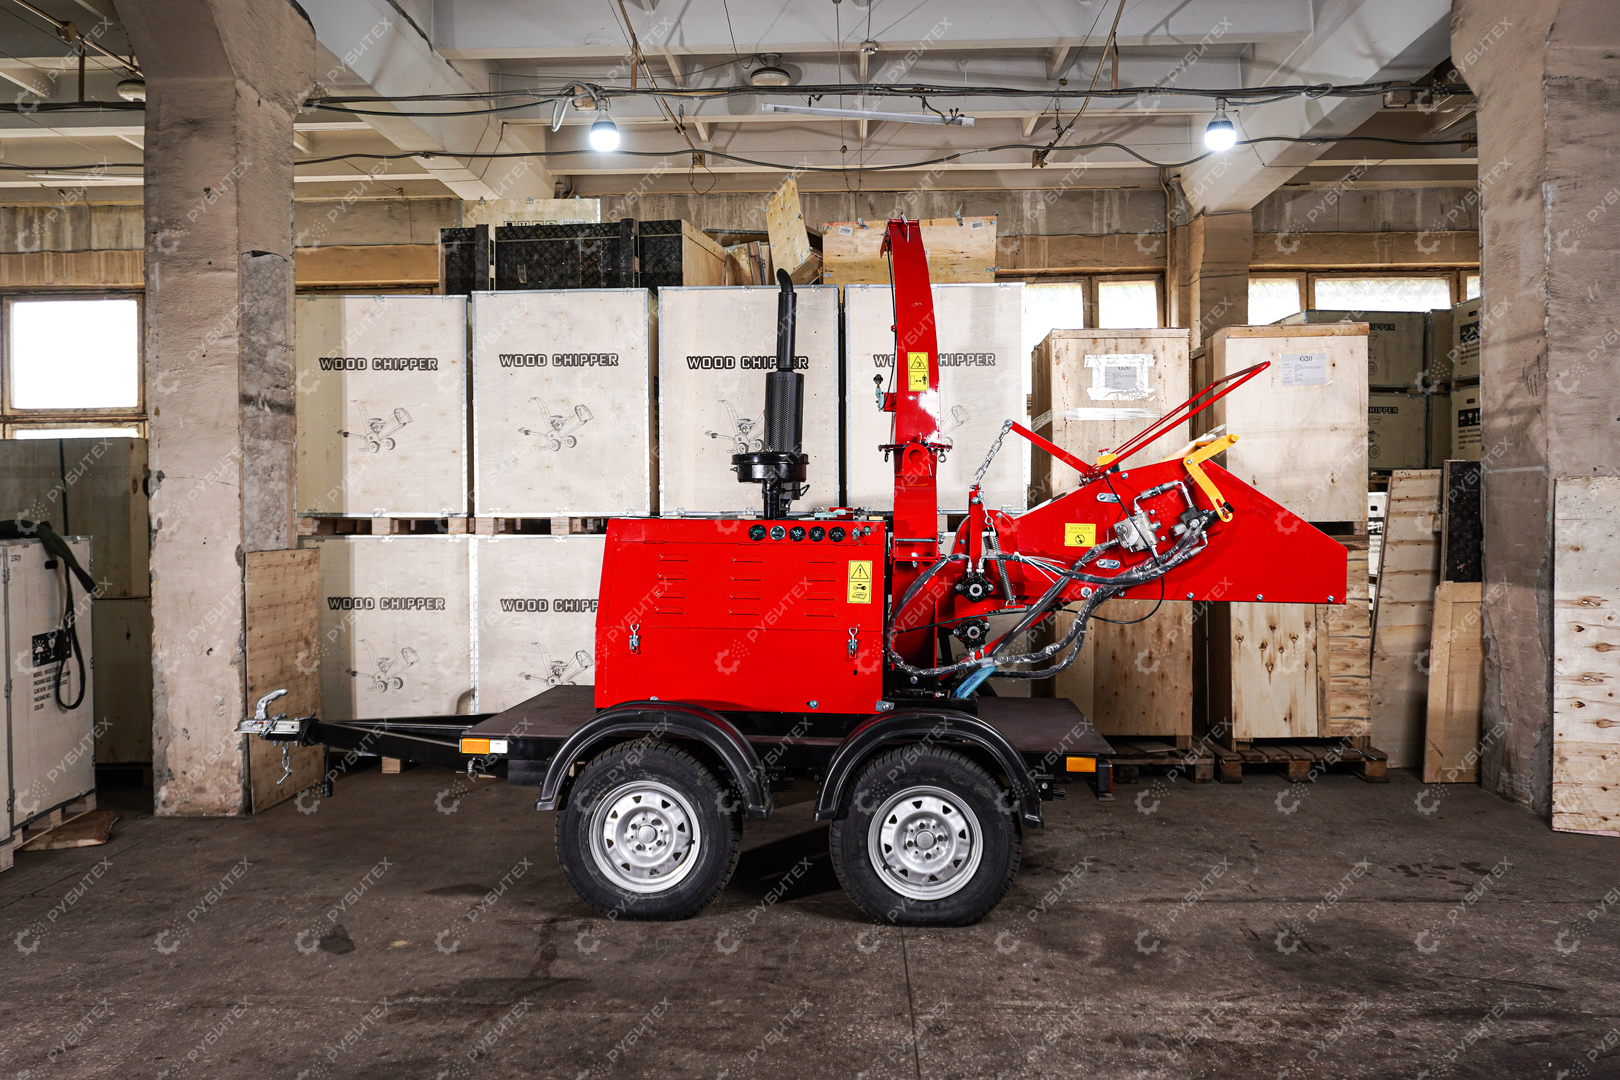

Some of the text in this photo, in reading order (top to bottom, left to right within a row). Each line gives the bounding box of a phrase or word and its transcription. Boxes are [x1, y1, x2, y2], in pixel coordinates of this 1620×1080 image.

[319, 358, 438, 370] WOOD CHIPPER
[499, 353, 619, 367] WOOD CHIPPER
[687, 356, 809, 369] WOOD CHIPR
[937, 353, 996, 366] HIPPER
[1368, 406, 1399, 414] HIPPER
[327, 597, 445, 610] WOOD CHIPPER
[500, 599, 599, 612] WOOD CHIPP
